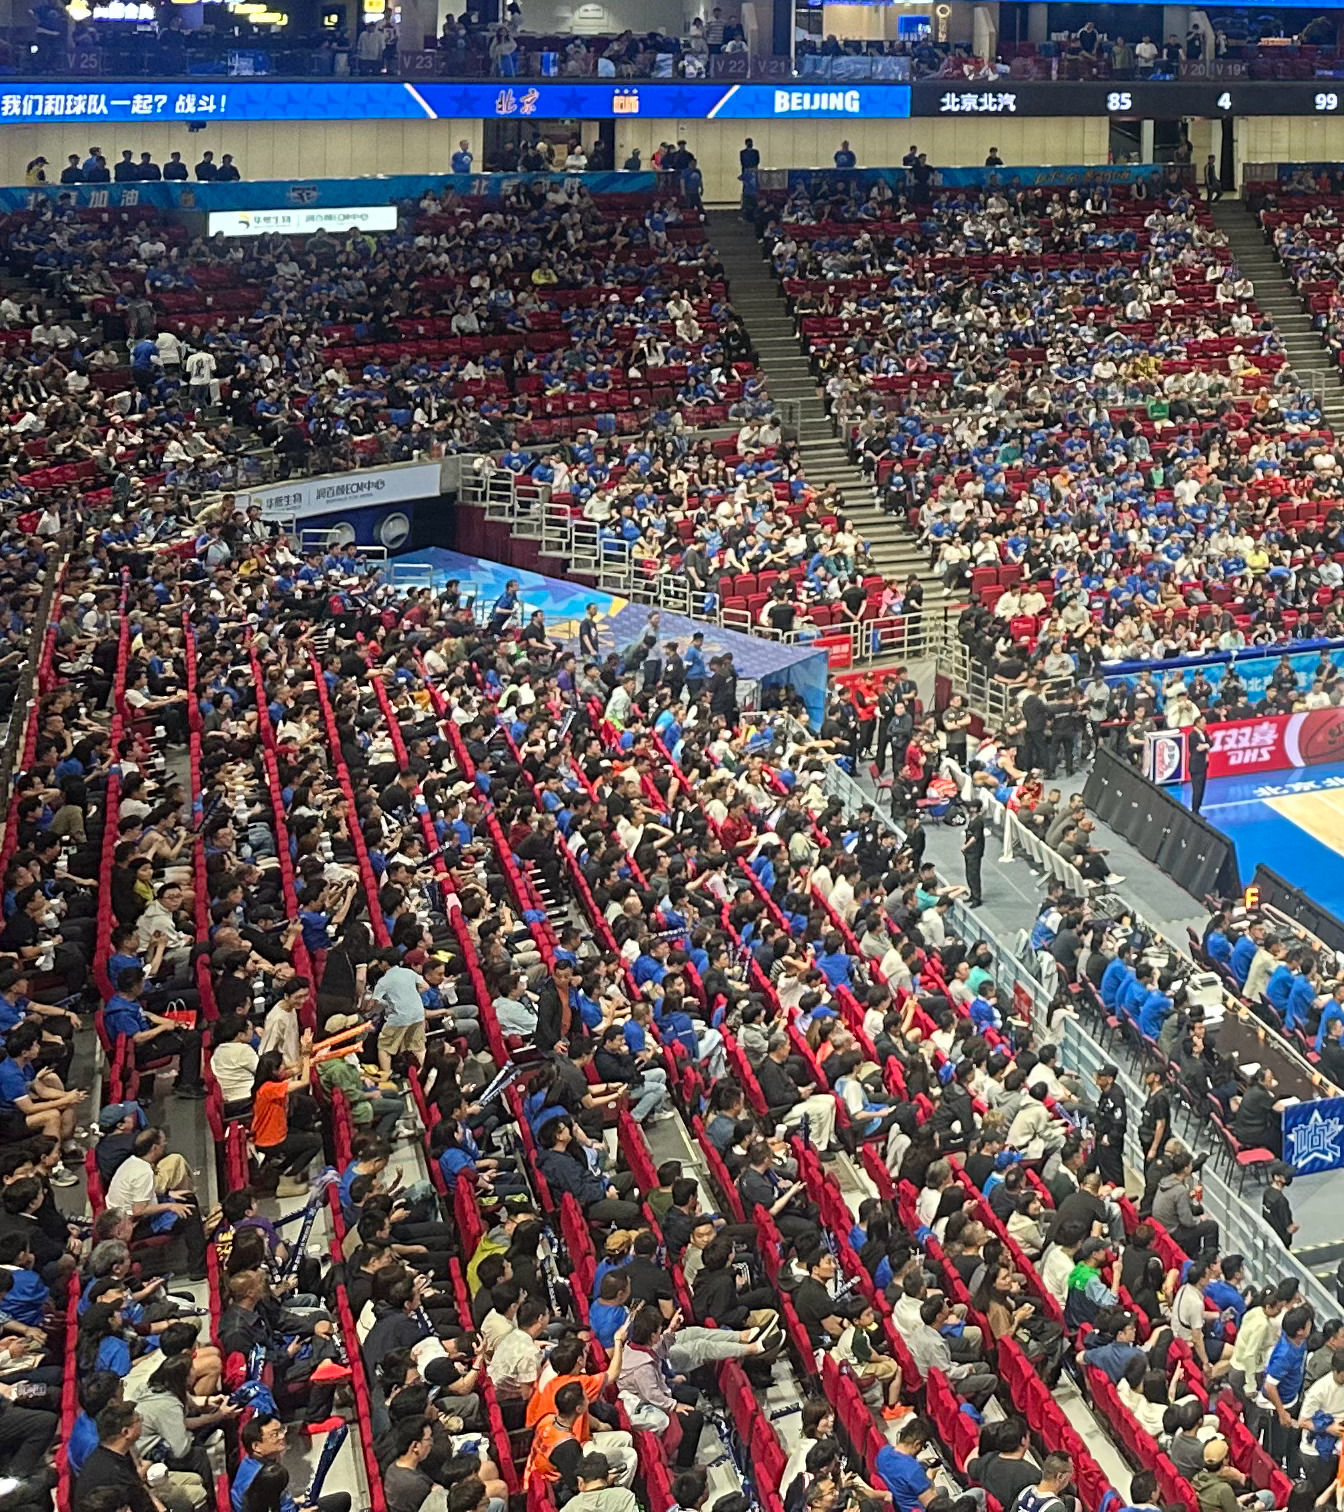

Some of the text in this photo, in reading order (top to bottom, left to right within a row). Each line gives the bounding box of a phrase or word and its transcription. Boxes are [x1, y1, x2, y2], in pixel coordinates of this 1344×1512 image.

[496, 87, 540, 115] 北京
[774, 90, 860, 113] BEIJING
[940, 92, 1017, 112] 北京北汽
[1107, 92, 1132, 111] 85
[1217, 92, 1232, 110] 4
[1315, 93, 1338, 111] 99
[1226, 745, 1276, 766] DHS
[1245, 887, 1261, 910] F
